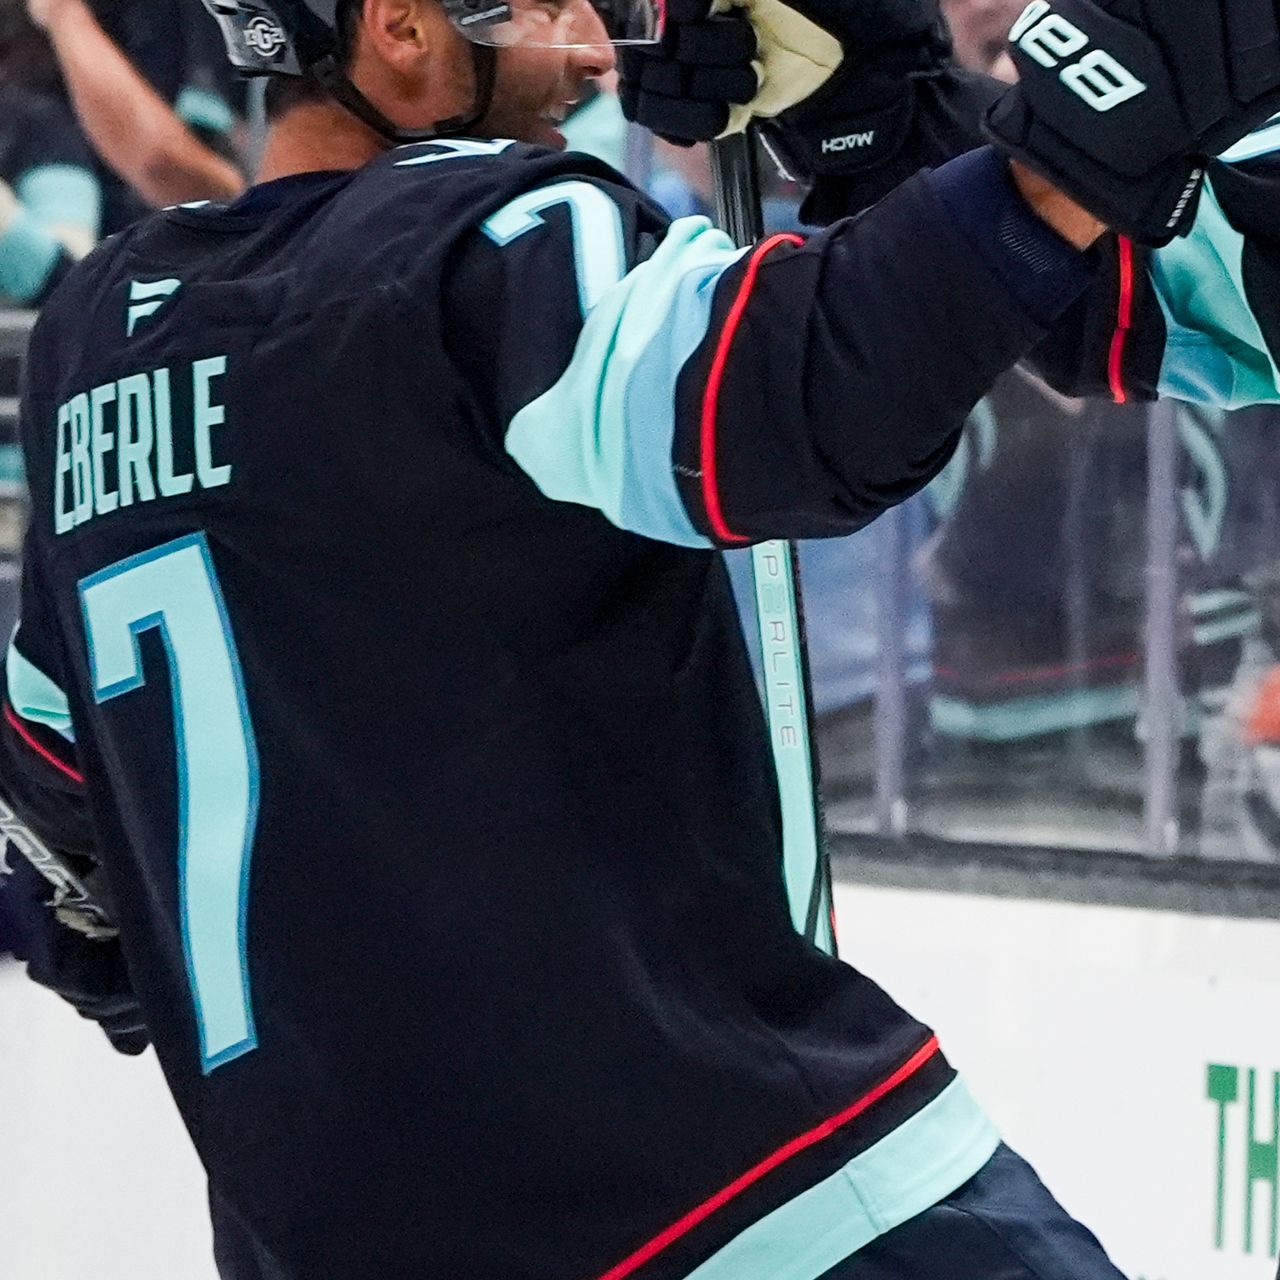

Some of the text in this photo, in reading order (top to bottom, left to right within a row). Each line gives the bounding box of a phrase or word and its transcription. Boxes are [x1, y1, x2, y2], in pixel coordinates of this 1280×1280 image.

[821, 130, 875, 154] MACH
[480, 180, 627, 320] 7
[55, 355, 233, 535] EBERLE
[77, 530, 260, 1074] 7
